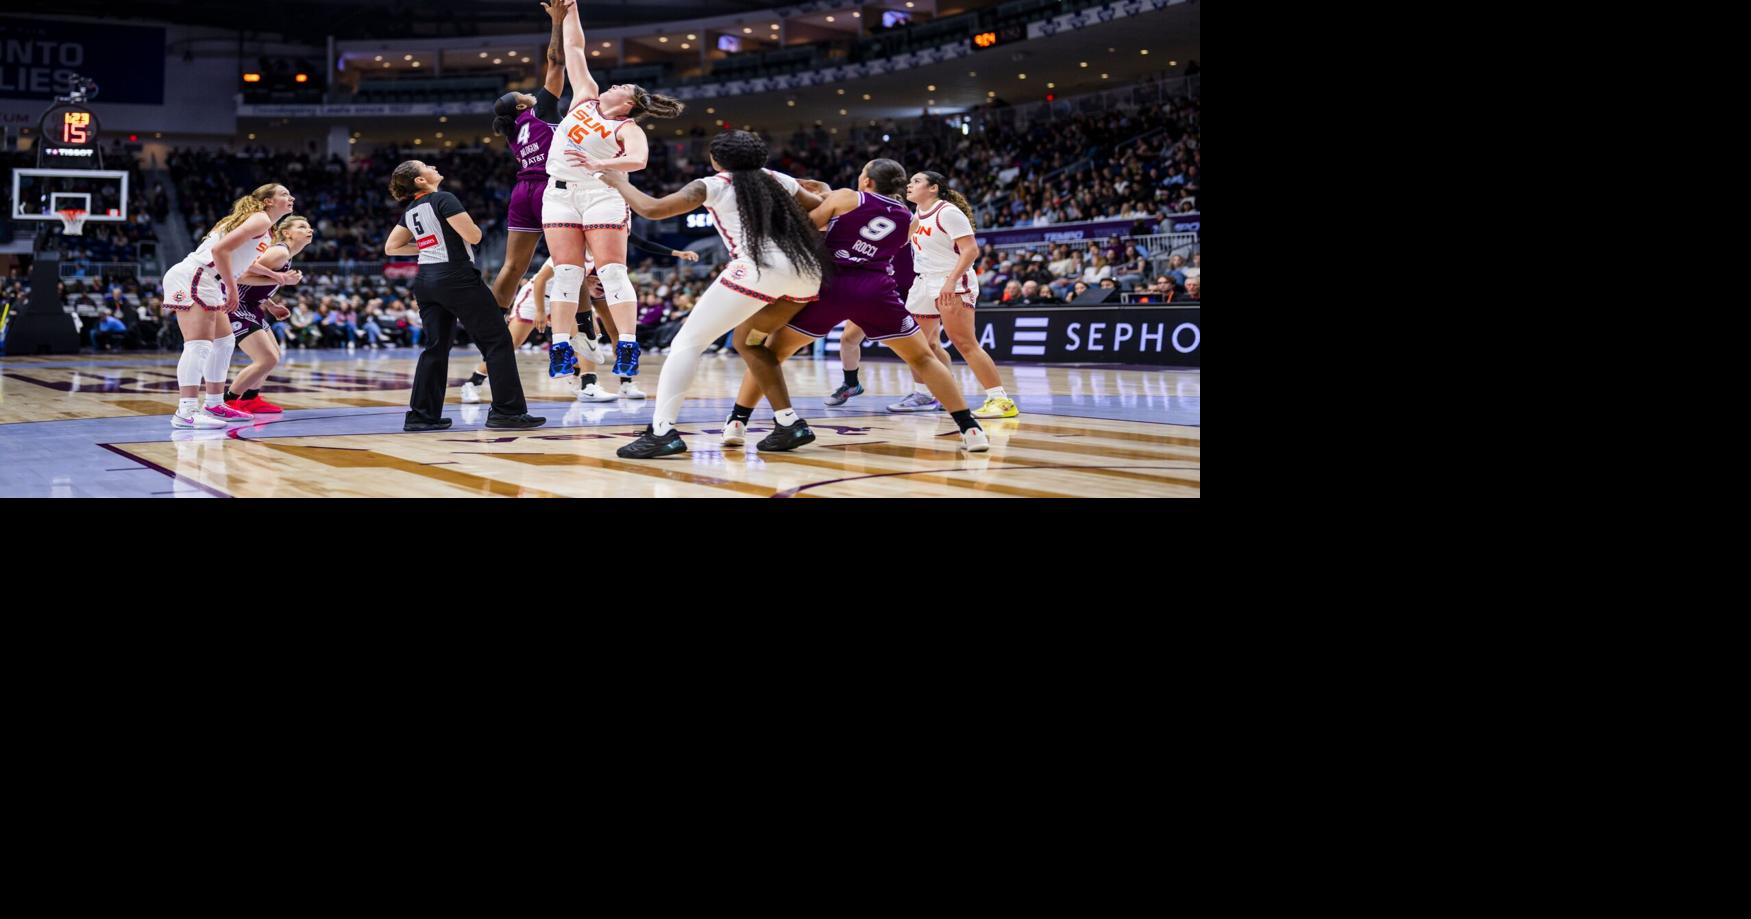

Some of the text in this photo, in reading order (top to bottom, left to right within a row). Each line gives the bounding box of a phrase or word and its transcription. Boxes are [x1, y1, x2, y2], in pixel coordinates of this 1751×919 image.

[0, 39, 84, 67] NTO
[64, 124, 87, 143] 15
[517, 122, 530, 146] 4
[567, 124, 590, 145] 15
[573, 109, 612, 139] SUN
[528, 153, 545, 165] AT&T
[412, 212, 424, 235] 5
[860, 216, 896, 241] 9
[852, 239, 878, 257] ROCCI
[1044, 231, 1084, 242] TEMPO
[1065, 321, 1200, 353] SEPHO
